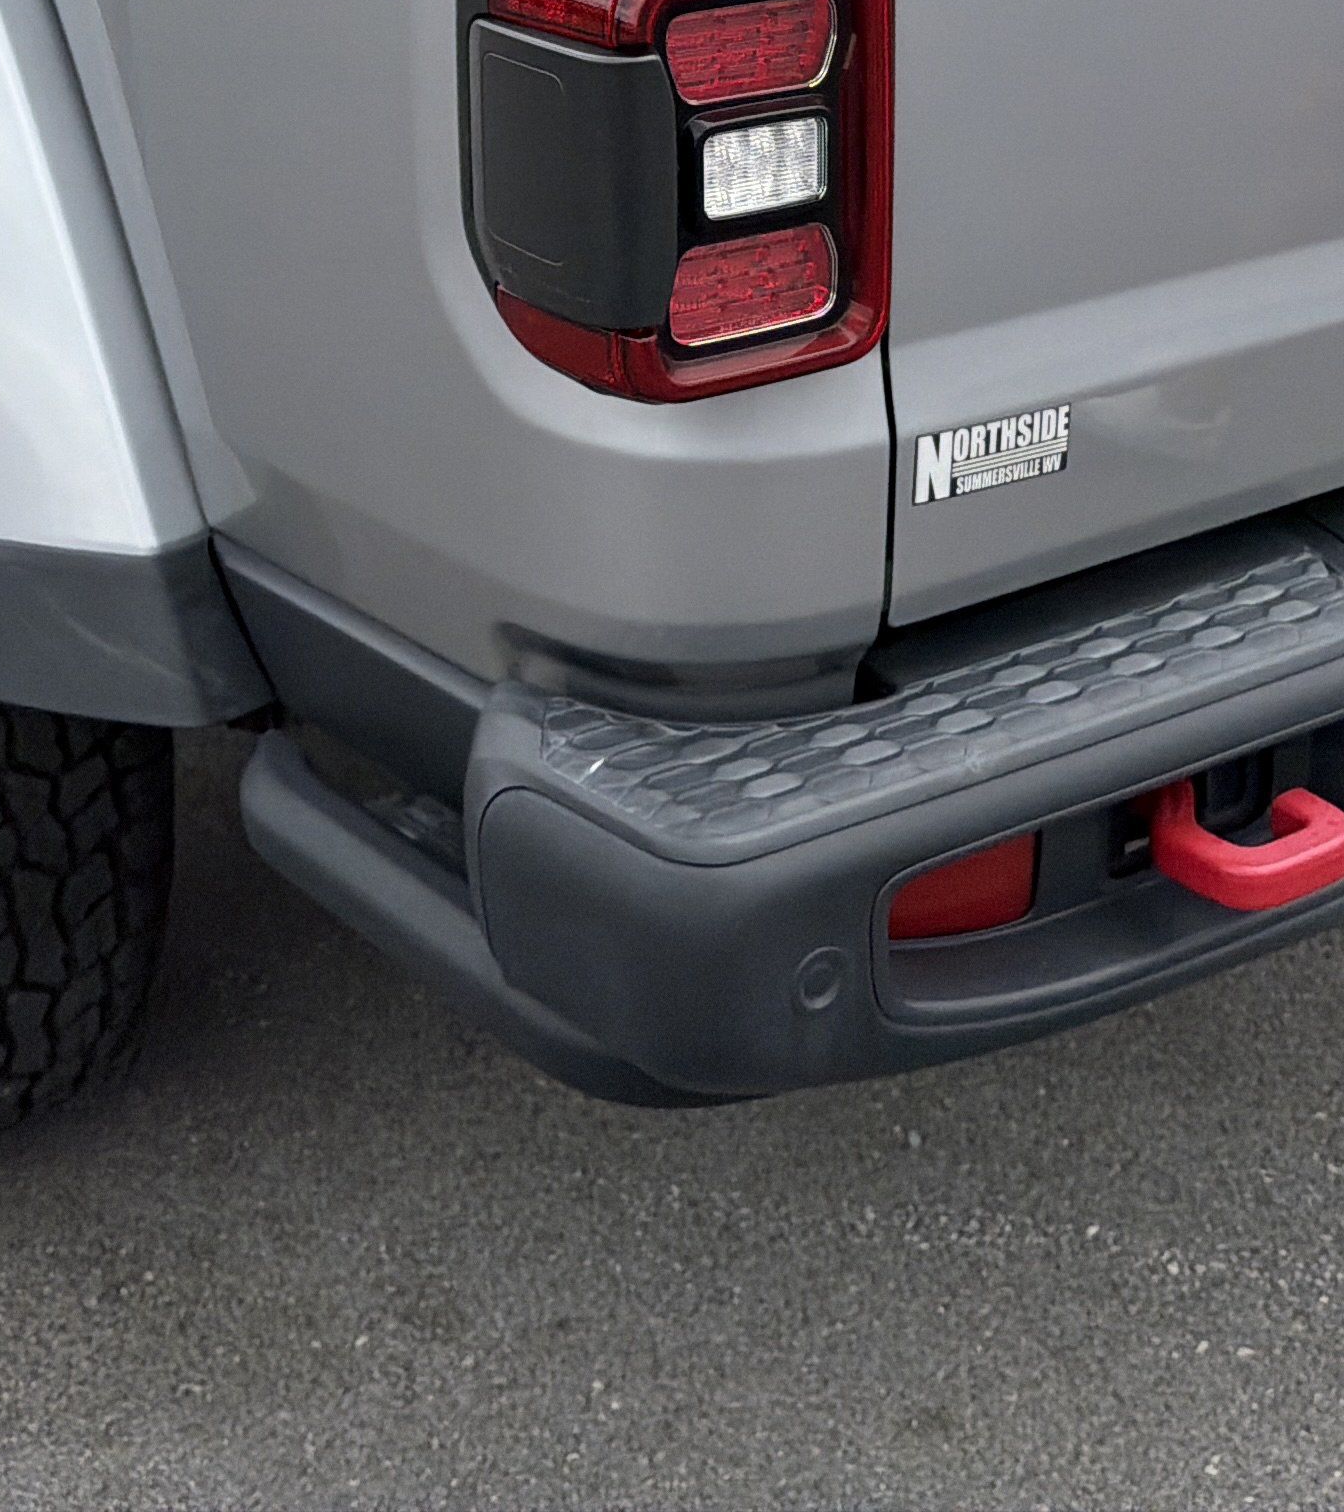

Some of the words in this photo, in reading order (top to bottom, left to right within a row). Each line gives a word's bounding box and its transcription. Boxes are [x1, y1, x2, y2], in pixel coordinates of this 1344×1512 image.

[914, 404, 1070, 504] NORTHSIDE
[956, 458, 1040, 495] SUMMERSVILLE
[1042, 452, 1061, 474] WV
